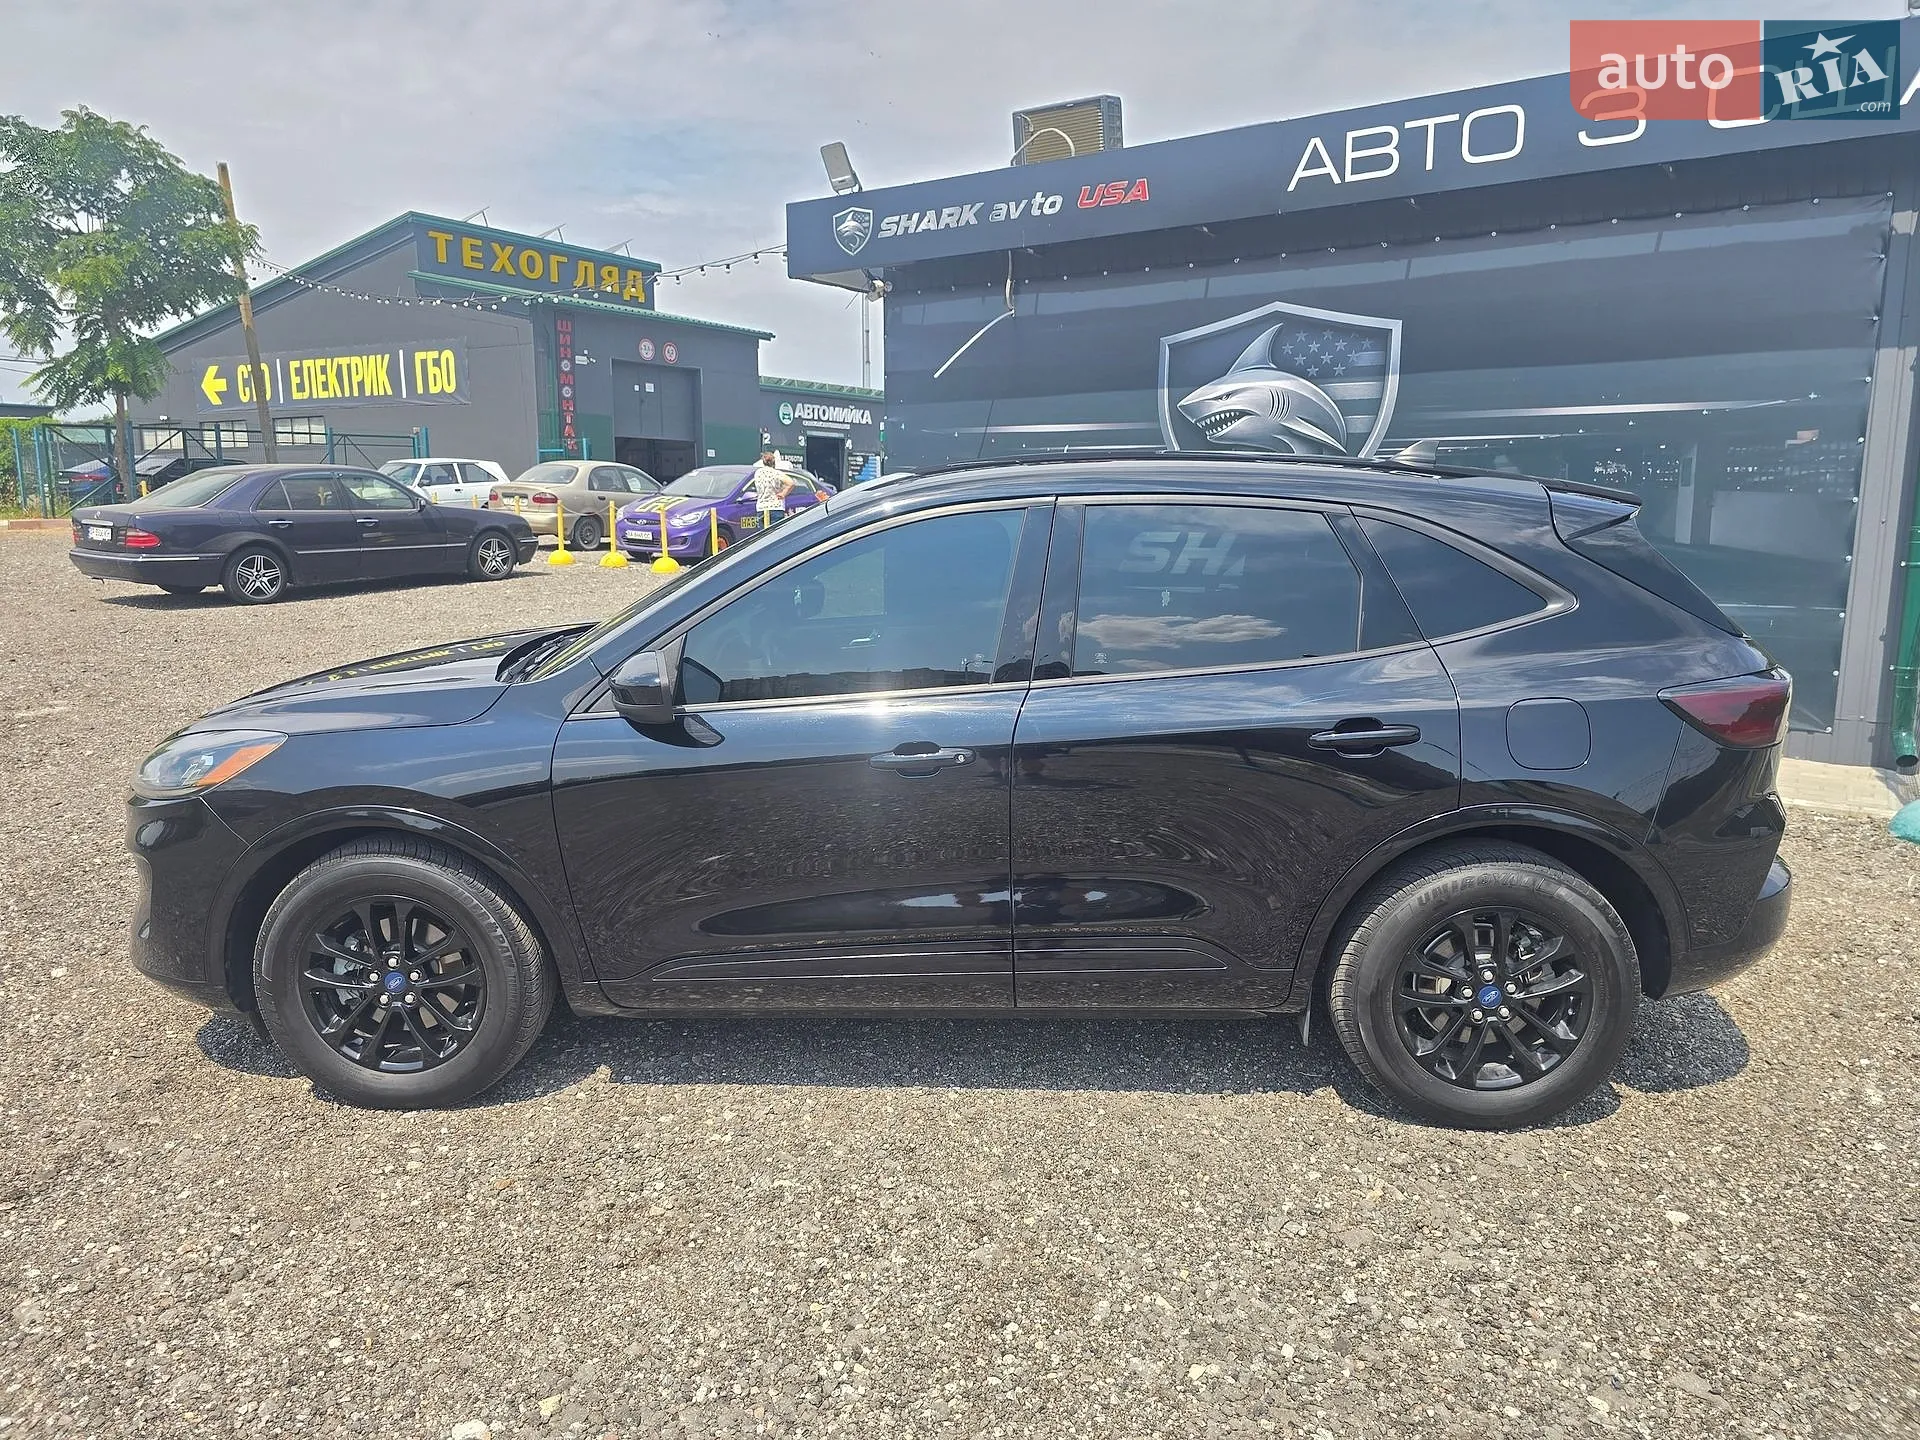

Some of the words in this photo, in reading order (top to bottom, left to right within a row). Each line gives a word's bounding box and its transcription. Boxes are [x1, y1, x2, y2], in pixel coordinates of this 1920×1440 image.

[1286, 103, 1526, 192] АВТО
[1707, 45, 1920, 130] СШ
[878, 202, 985, 239] SHARK
[988, 191, 1064, 222] avto
[1076, 178, 1151, 210] USA
[427, 230, 645, 303] ТЕХОГЛЯД
[289, 353, 393, 400] ЕЛЕКТРИК
[414, 349, 457, 395] ГБО
[795, 403, 873, 425] АВТОМИЙКА
[762, 433, 771, 445] 2
[798, 435, 805, 447] 3
[845, 439, 853, 450] 4
[1117, 531, 1247, 576] SH
